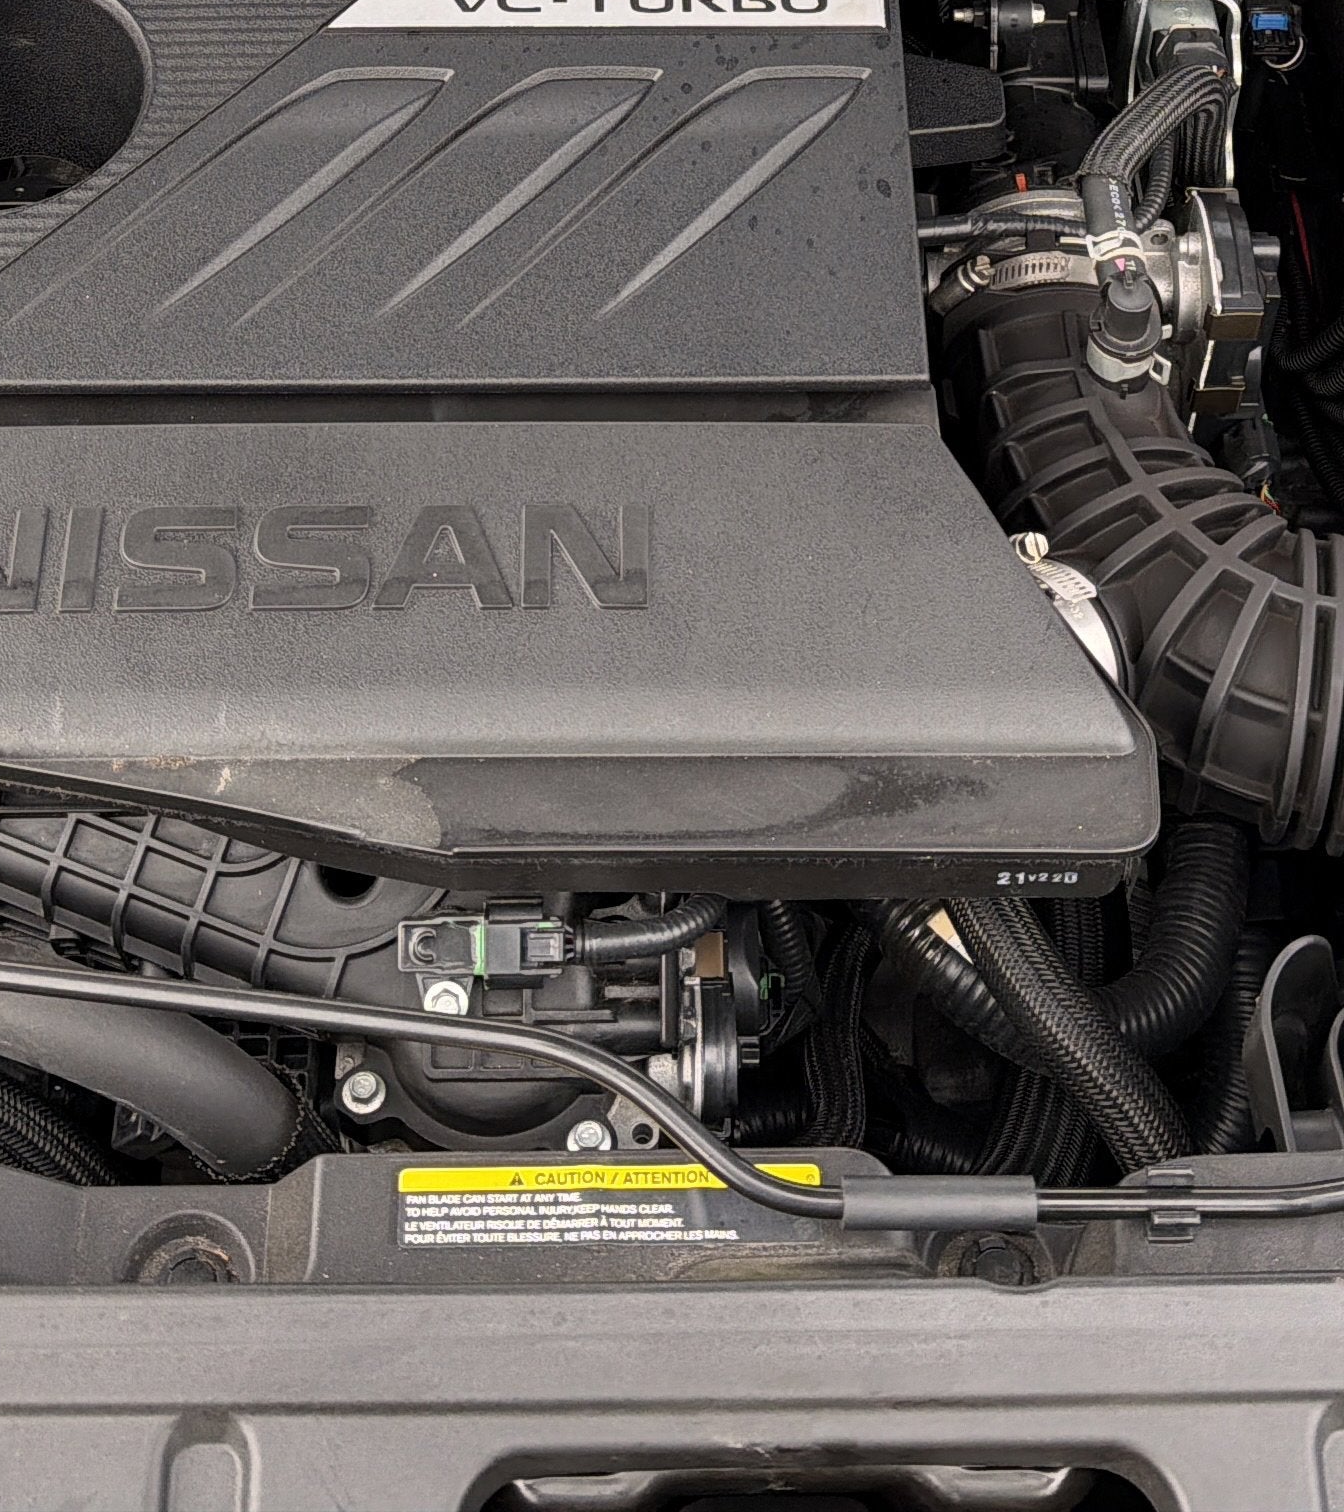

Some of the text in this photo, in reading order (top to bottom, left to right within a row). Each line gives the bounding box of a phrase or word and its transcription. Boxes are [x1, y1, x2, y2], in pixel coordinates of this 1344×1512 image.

[535, 1171, 605, 1186] CAUTION
[623, 1170, 709, 1185] ATTENTION
[406, 1192, 582, 1205] FAN BLADE CAN START AT ANY TIME.
[406, 1207, 420, 1217] TO
[422, 1207, 448, 1216] HELP
[450, 1206, 481, 1216] AVOID
[483, 1206, 537, 1216] PERSONAL
[601, 1204, 637, 1214] HANDS
[639, 1204, 675, 1214] CLEAR.
[405, 1221, 418, 1231] LE
[419, 1220, 484, 1231] VENTILATEUR
[486, 1220, 525, 1230] RISQUE
[527, 1220, 541, 1229] DE
[543, 1217, 599, 1229] DÉMARRER
[609, 1218, 636, 1228] TOUT
[638, 1218, 685, 1228] MOMENT.
[405, 1234, 434, 1244] POUR
[436, 1231, 470, 1243] ÉVITER
[472, 1233, 505, 1243] TOUTE
[564, 1231, 580, 1241] NE
[581, 1230, 601, 1240] PAS
[603, 1230, 617, 1240] EN
[618, 1230, 682, 1241] APPROCHER
[684, 1230, 703, 1240] LES
